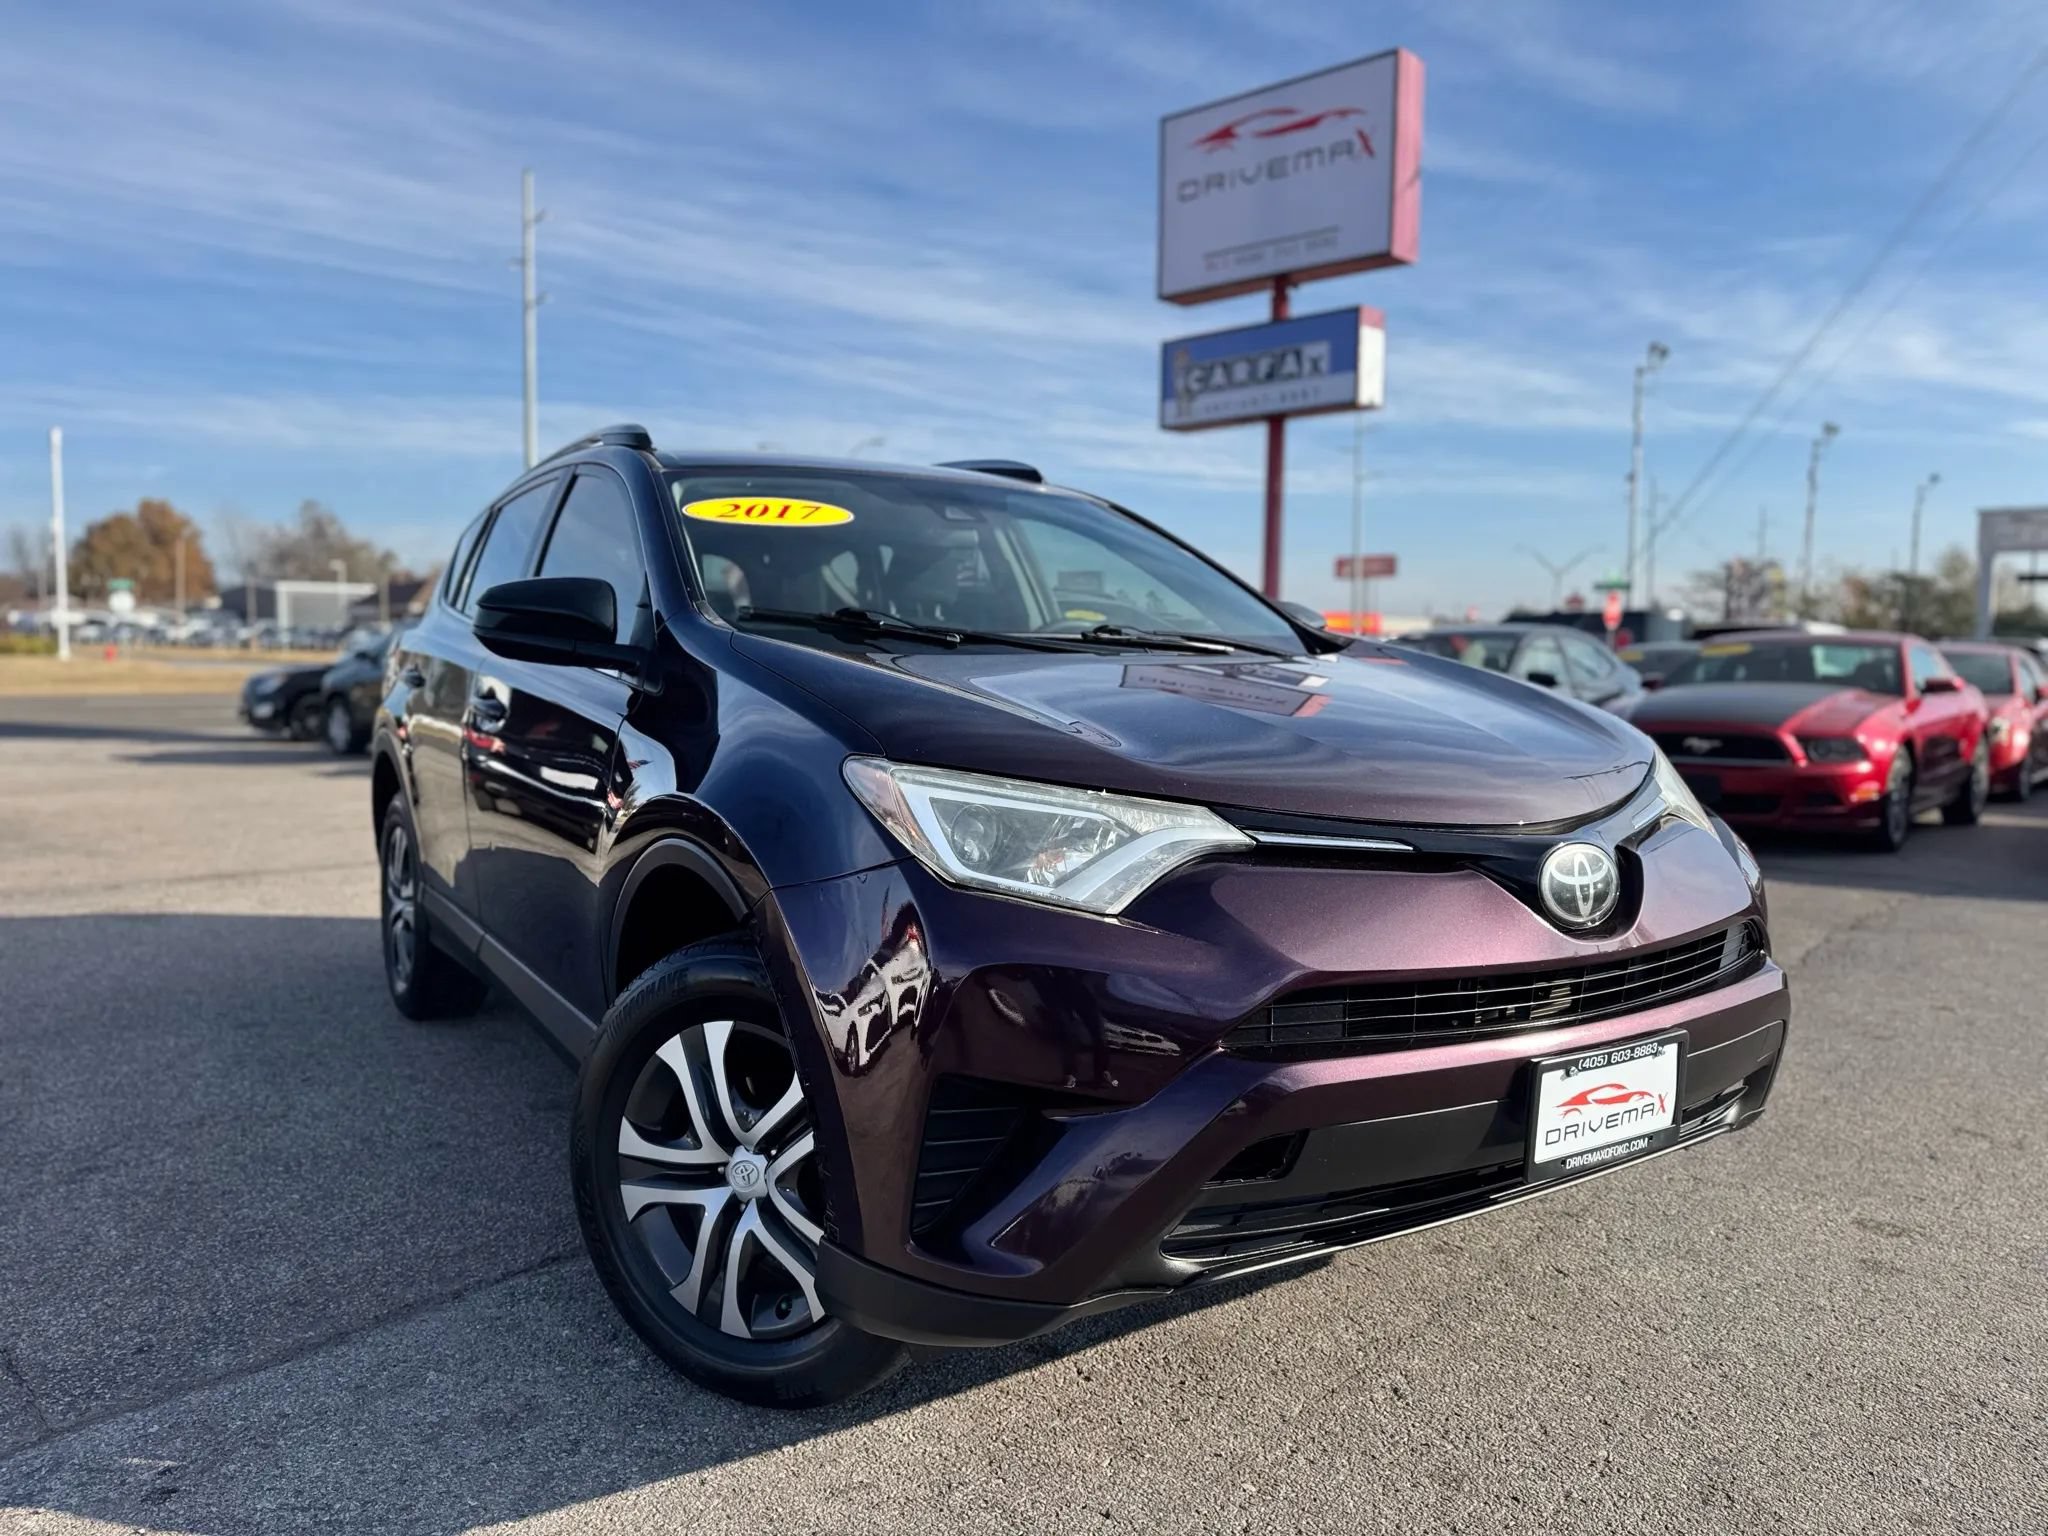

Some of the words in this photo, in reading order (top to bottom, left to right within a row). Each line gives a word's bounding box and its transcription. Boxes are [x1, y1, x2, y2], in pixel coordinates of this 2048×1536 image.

[1177, 126, 1376, 202] DRIVEMAX
[716, 503, 822, 520] 2017
[1578, 1054, 1608, 1070] (405)
[1611, 1042, 1658, 1064] 603-8883
[1545, 1092, 1668, 1146] DRIVEMAX
